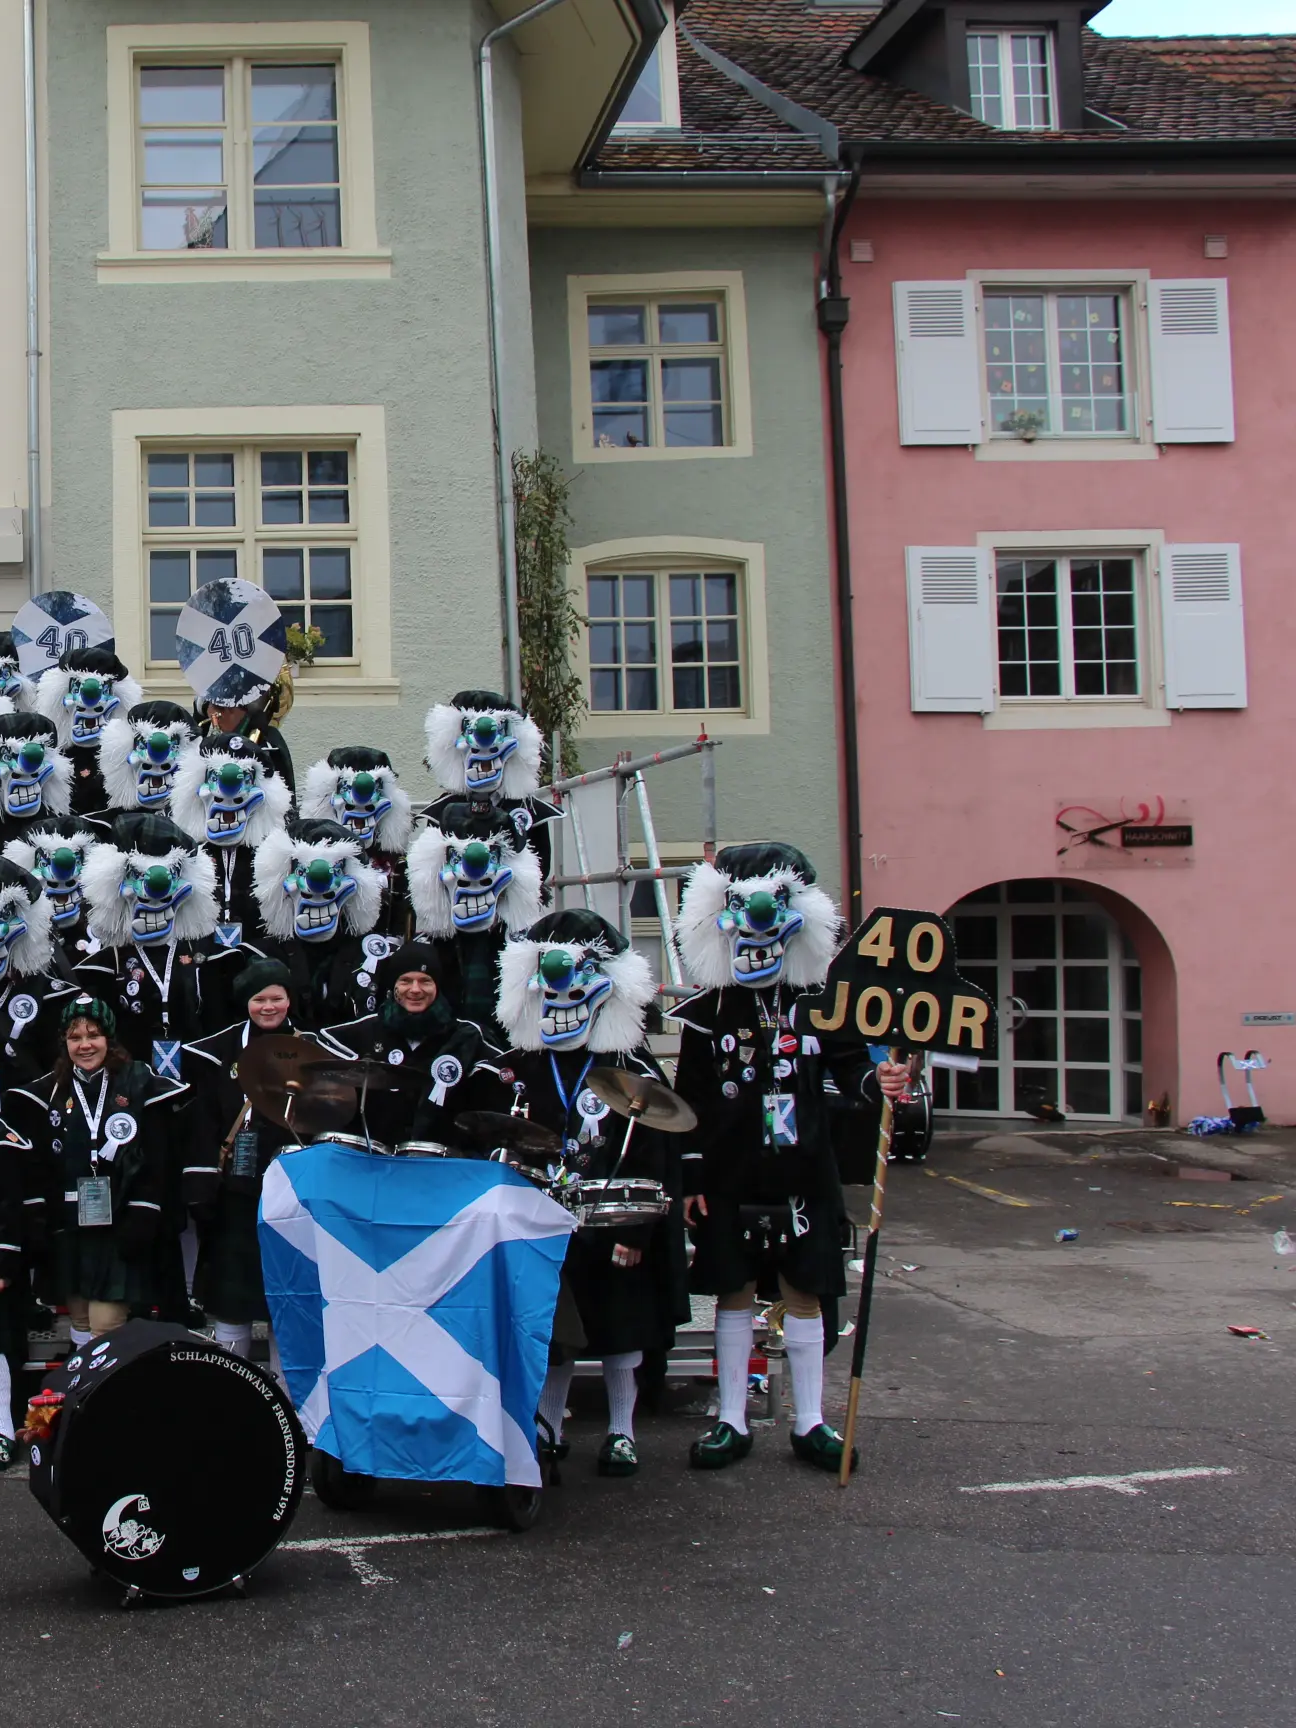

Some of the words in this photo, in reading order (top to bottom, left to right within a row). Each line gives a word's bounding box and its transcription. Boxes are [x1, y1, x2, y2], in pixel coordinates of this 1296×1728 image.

[36, 624, 89, 660] 40
[208, 621, 256, 663] 40
[857, 915, 944, 973] 40
[809, 980, 989, 1049] JOOR
[170, 1350, 274, 1402] SCHLAPPSCHWÄNZ
[271, 1402, 295, 1494] FRENKENDORF
[272, 1495, 290, 1521] 1978
